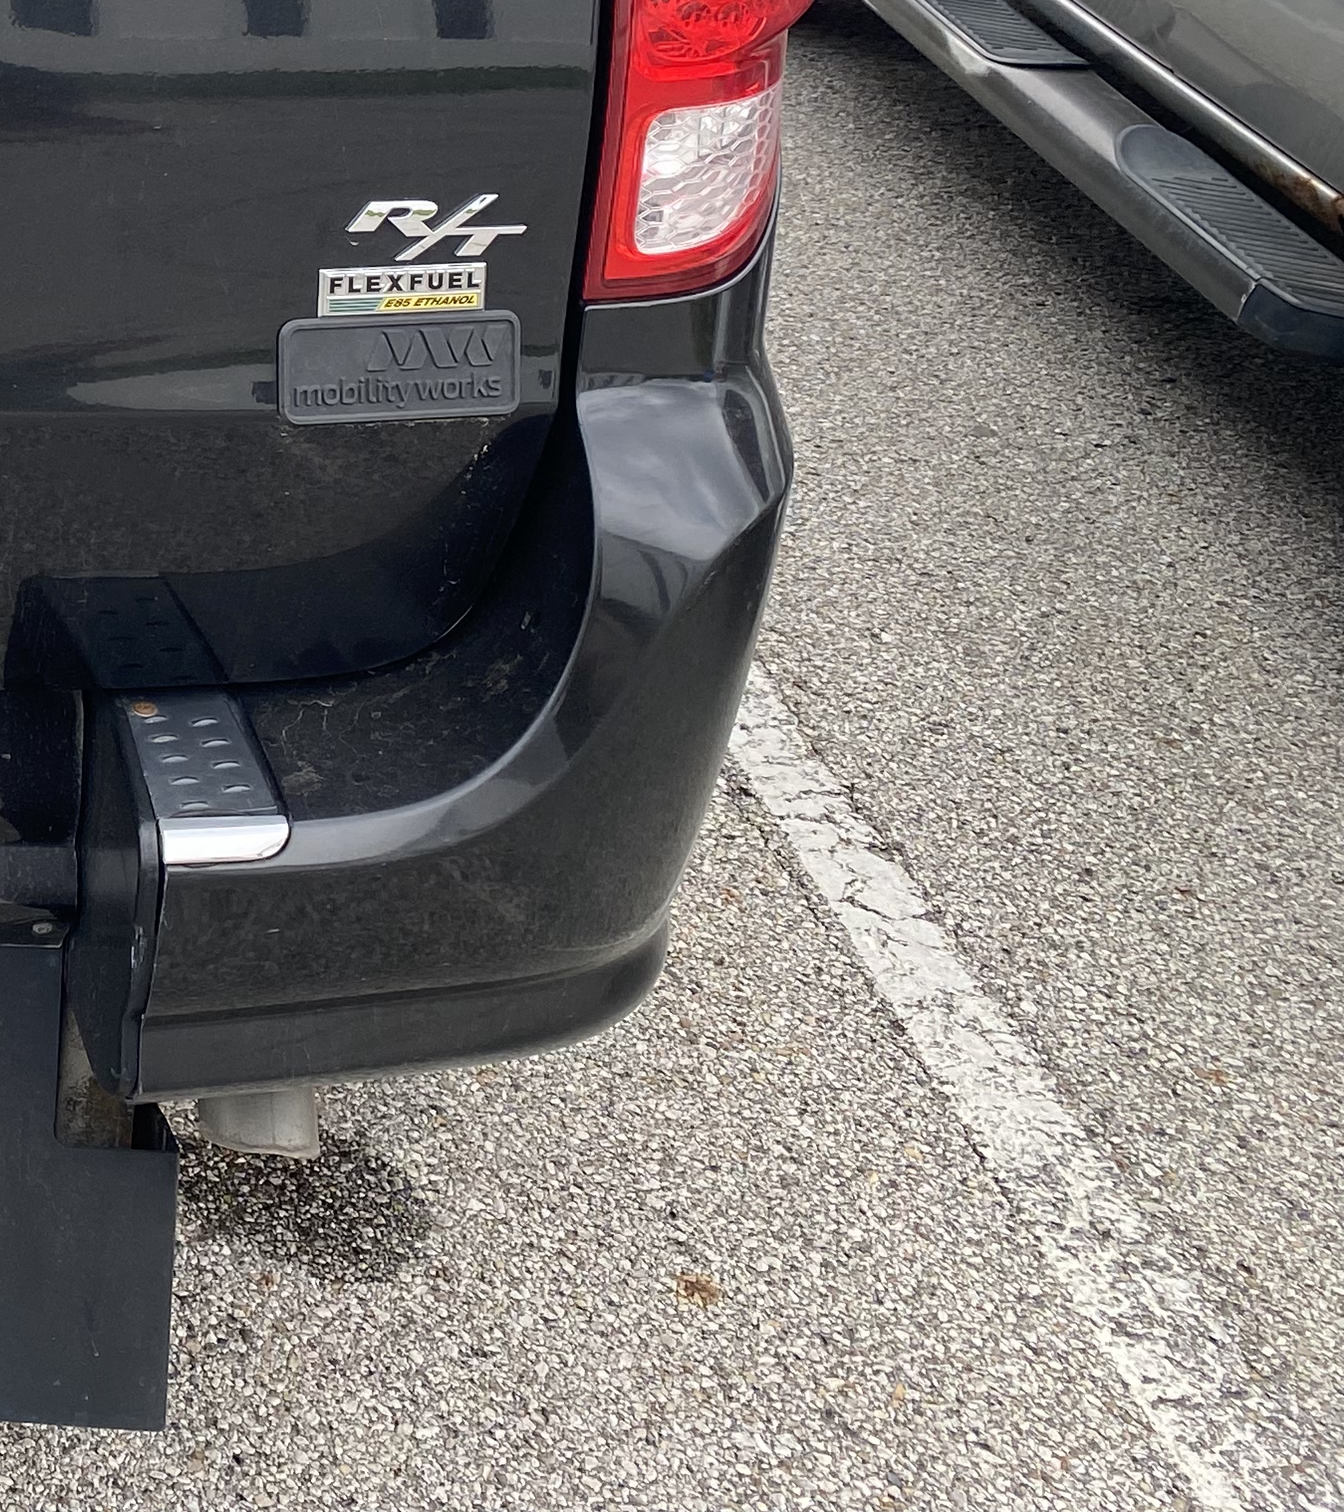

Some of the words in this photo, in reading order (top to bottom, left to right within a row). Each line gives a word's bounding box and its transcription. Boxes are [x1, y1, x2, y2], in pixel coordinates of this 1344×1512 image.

[328, 270, 482, 295] FLEXFUEL
[384, 298, 411, 308] E85
[413, 295, 475, 307] ETHANOL
